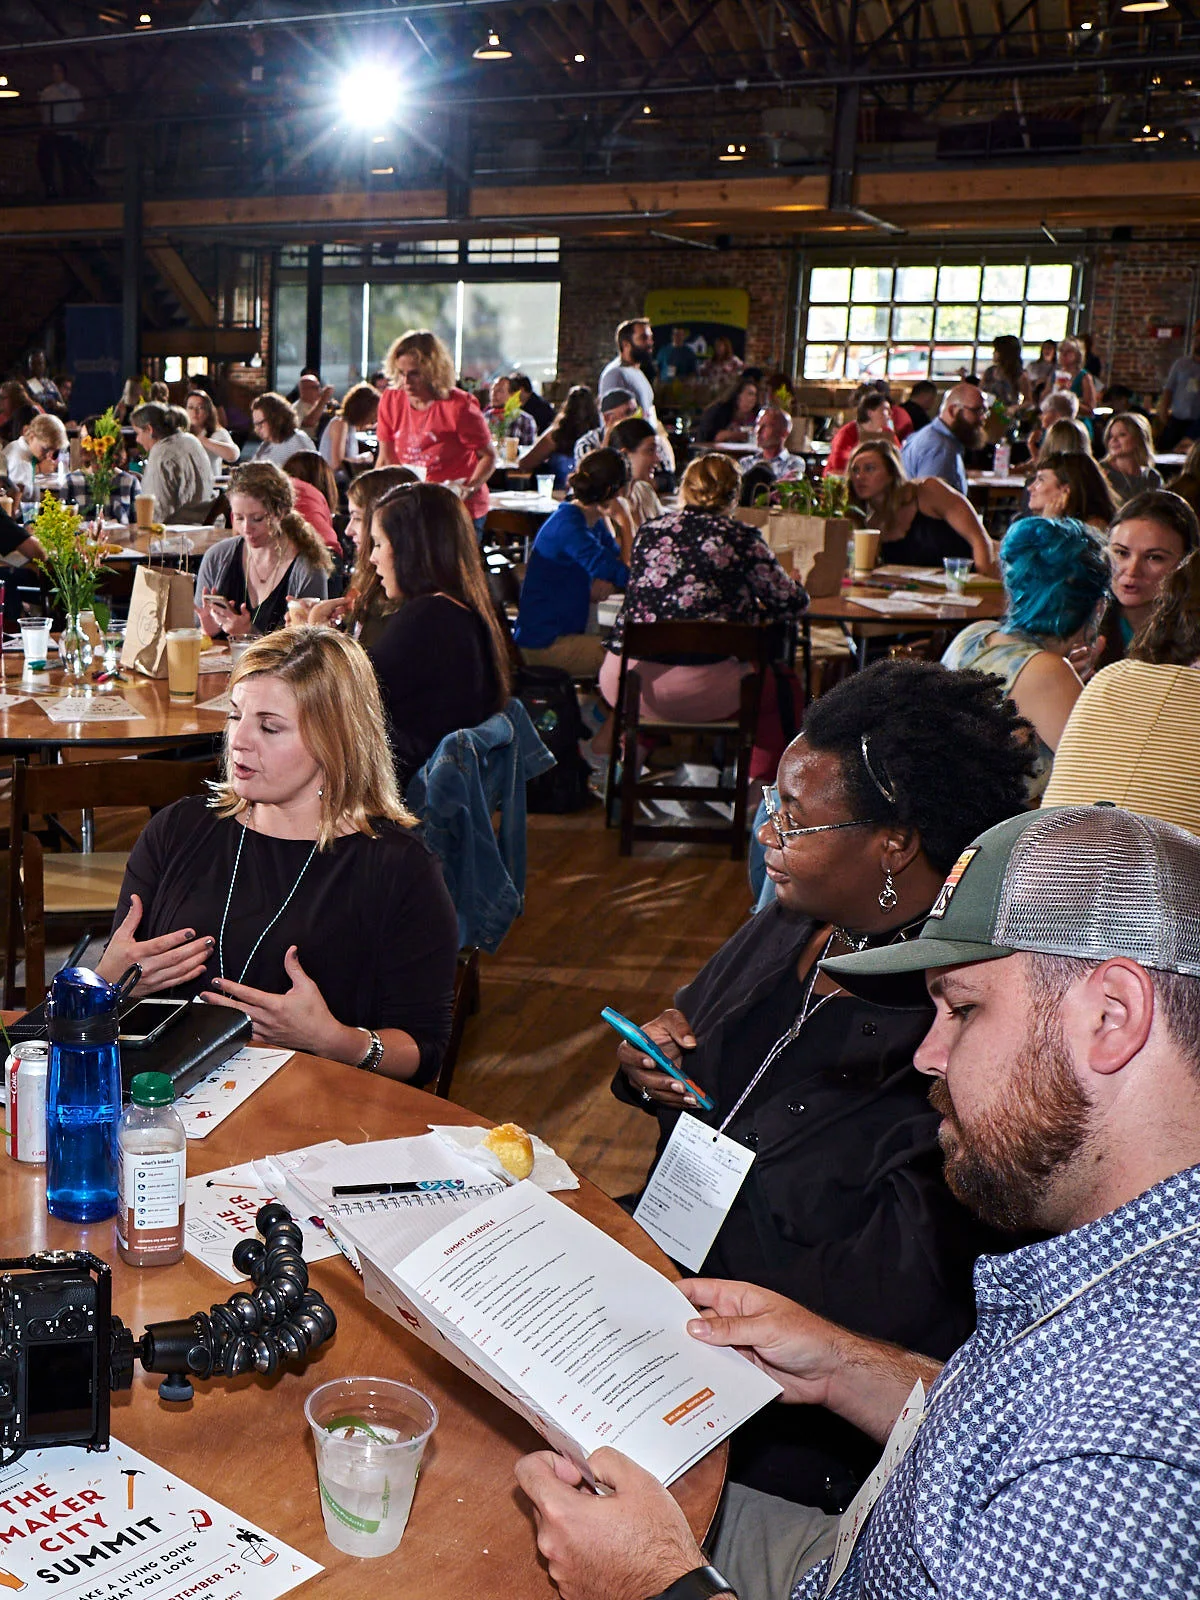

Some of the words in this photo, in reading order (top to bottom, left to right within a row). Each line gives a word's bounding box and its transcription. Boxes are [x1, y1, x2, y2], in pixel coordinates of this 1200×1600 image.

[216, 1209, 255, 1234] THE
[441, 1236, 469, 1257] SUMMIT
[464, 1217, 497, 1241] SCHEDULE
[36, 1516, 163, 1584] SUMMIT
[39, 1512, 109, 1552] CITY
[79, 1587, 104, 1600] AKE
[107, 1583, 118, 1591] A
[118, 1561, 159, 1584] LIVING
[160, 1540, 198, 1562] DOING
[135, 1573, 162, 1589] YOU
[163, 1555, 195, 1575] LOVE
[167, 1573, 225, 1600] PTEMBER
[224, 1562, 242, 1575] 23
